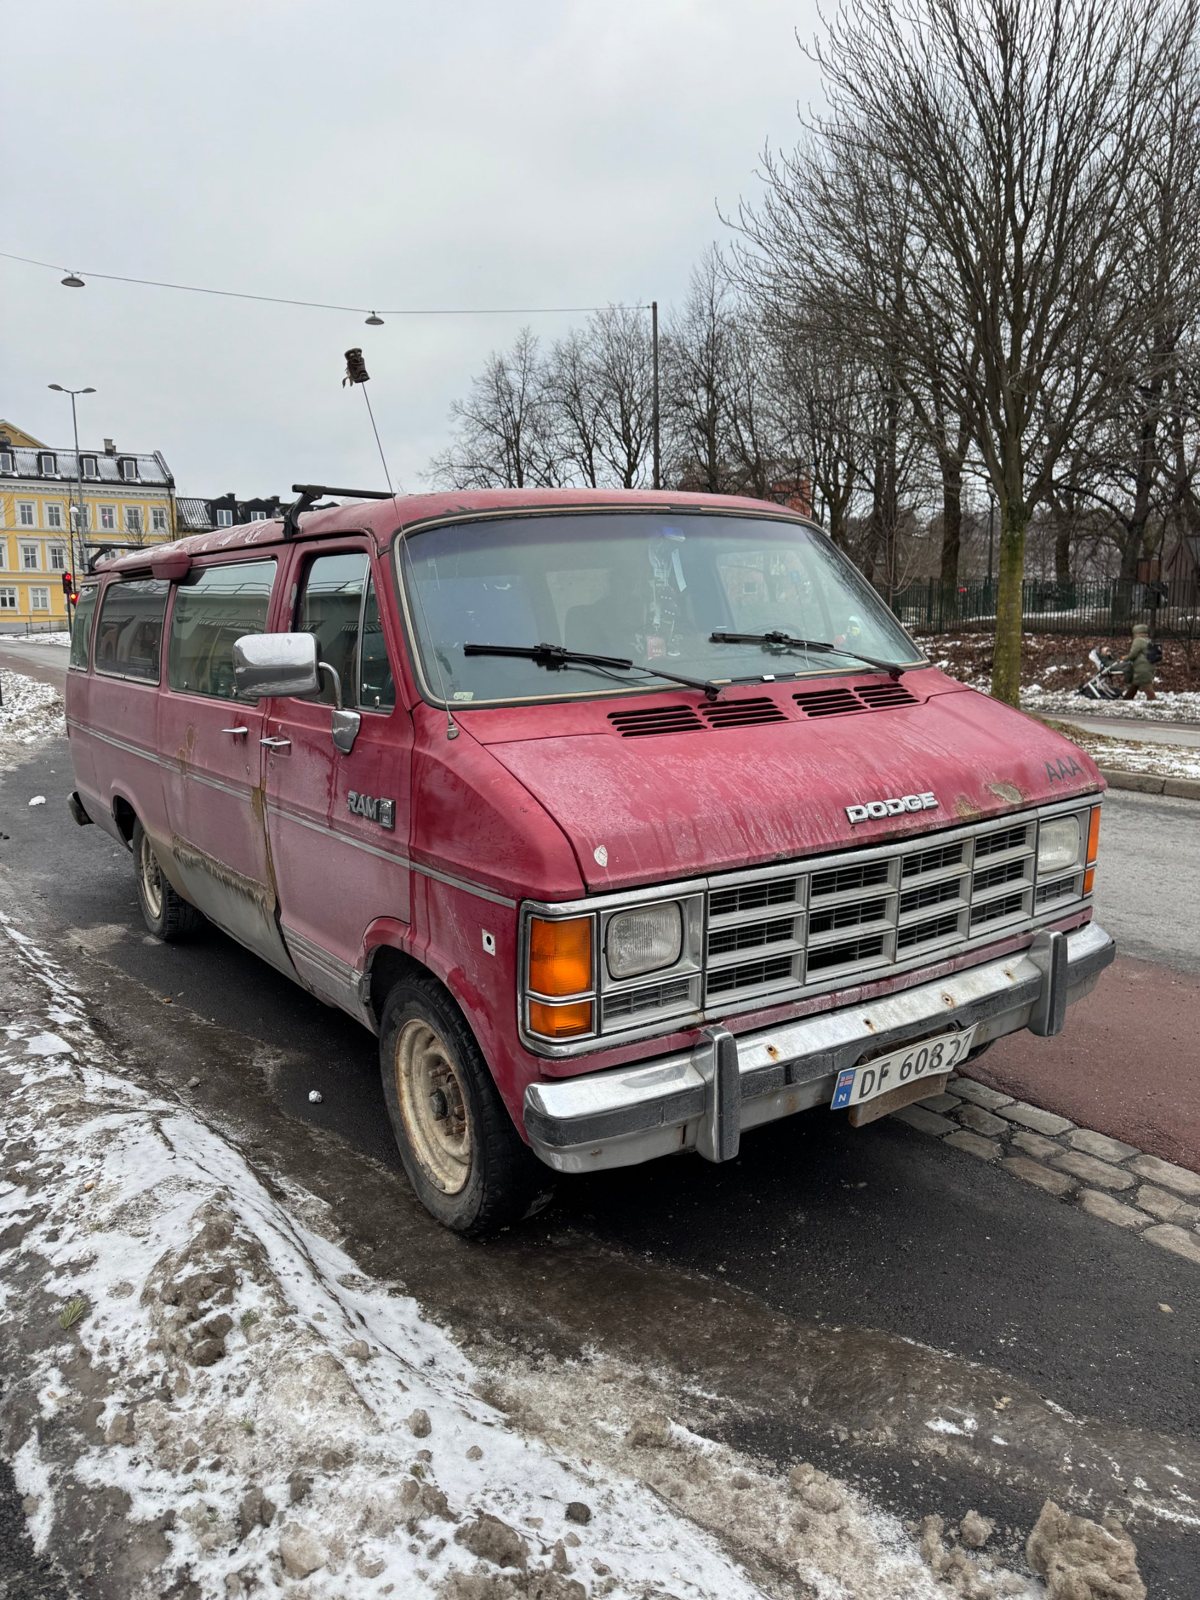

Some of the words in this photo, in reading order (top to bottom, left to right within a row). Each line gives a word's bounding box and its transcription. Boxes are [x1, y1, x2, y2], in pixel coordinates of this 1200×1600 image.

[1044, 755, 1083, 783] AAA
[347, 790, 378, 820] RAM
[845, 791, 939, 824] DODGE
[859, 1061, 891, 1099] DF
[899, 1031, 972, 1081] 60827
[838, 1093, 847, 1102] N
